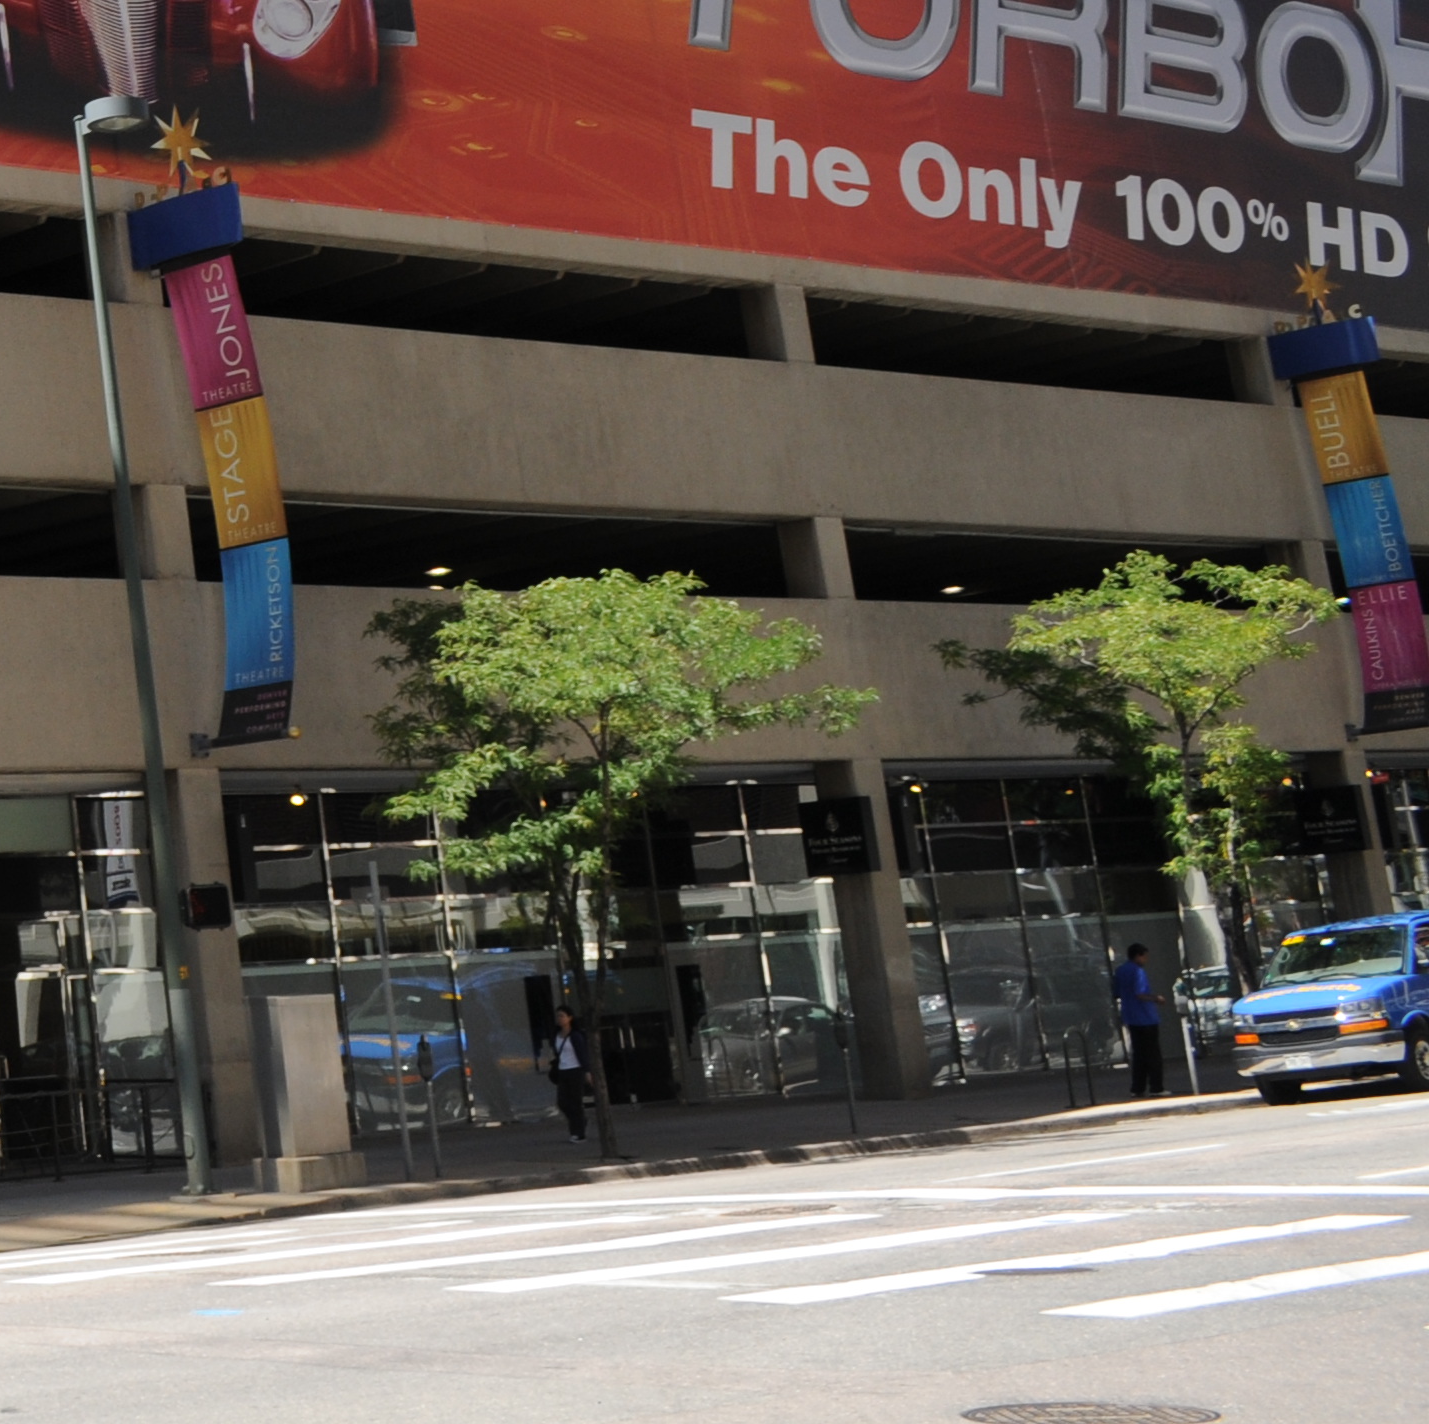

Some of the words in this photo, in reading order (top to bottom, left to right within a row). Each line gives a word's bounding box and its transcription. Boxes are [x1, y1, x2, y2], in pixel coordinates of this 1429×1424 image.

[691, 107, 871, 208] The
[898, 140, 1082, 250] Only
[1114, 174, 1291, 257] 100%
[1305, 200, 1411, 280] HD
[201, 263, 251, 379] JONES
[202, 379, 255, 403] THEATRE
[209, 407, 251, 524] STAGE
[1309, 390, 1352, 469] BUELL
[227, 521, 278, 543] THEATRE
[1370, 479, 1402, 572] BOETTCHER
[264, 546, 285, 663] RICKETSON
[1357, 585, 1408, 606] ELLIE
[234, 665, 285, 684] THEATRE
[1361, 609, 1385, 681] CAULKINS
[234, 700, 287, 715] PERFORMING
